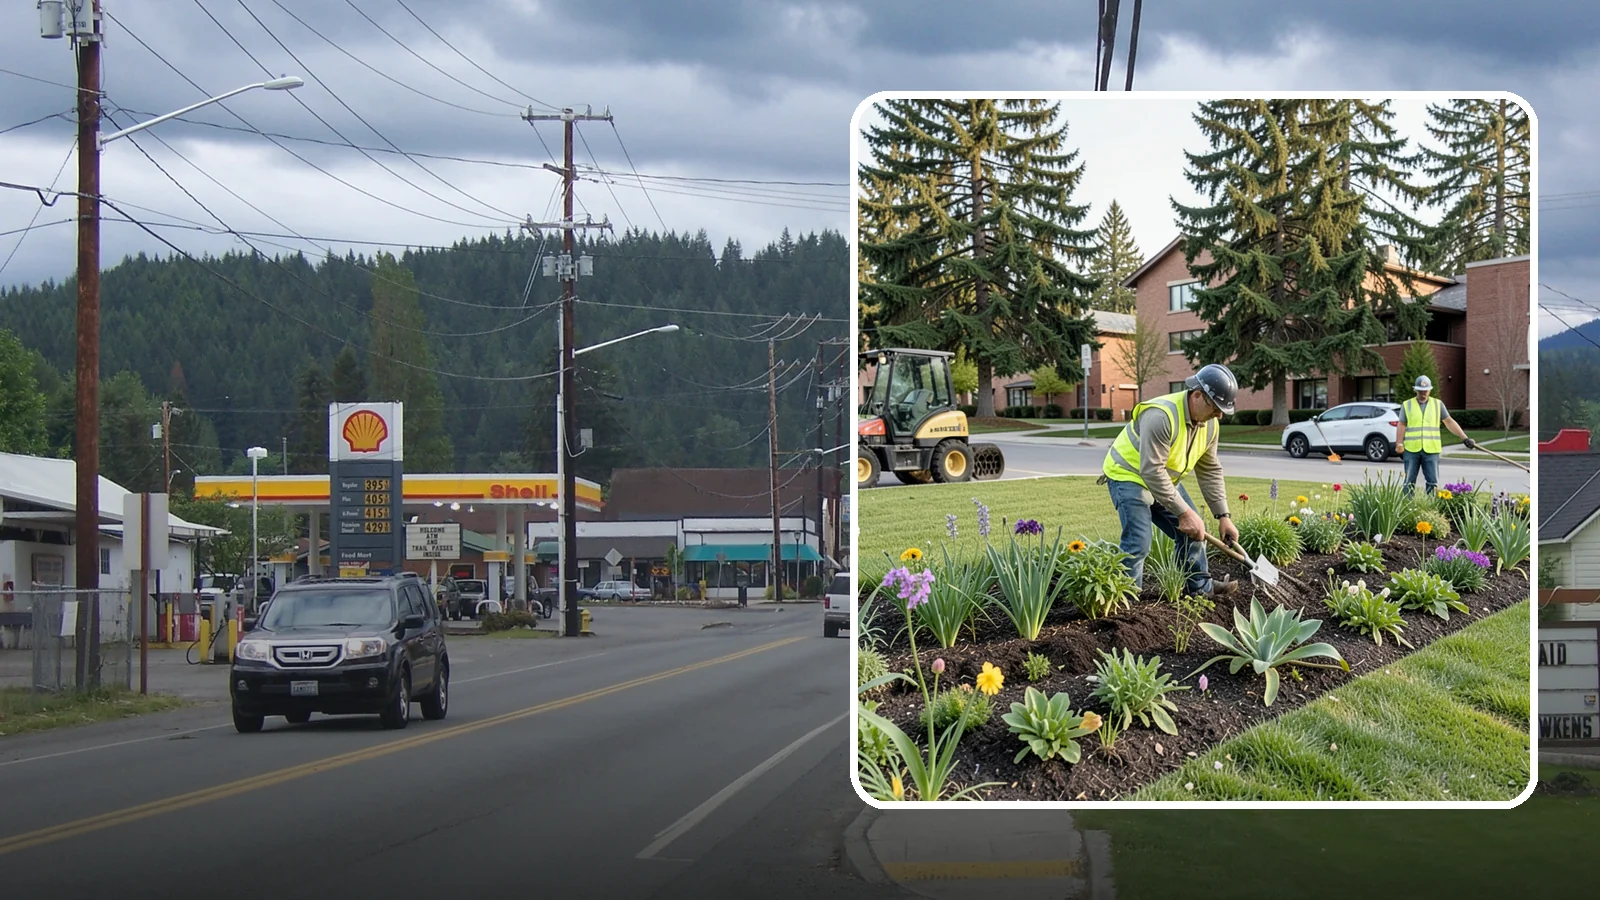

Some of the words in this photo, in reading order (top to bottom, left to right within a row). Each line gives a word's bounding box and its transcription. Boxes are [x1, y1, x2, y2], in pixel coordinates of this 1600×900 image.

[365, 480, 383, 490] 395
[490, 484, 547, 499] Shell
[365, 494, 383, 504] 405
[365, 508, 383, 518] 415
[365, 522, 383, 532] 429
